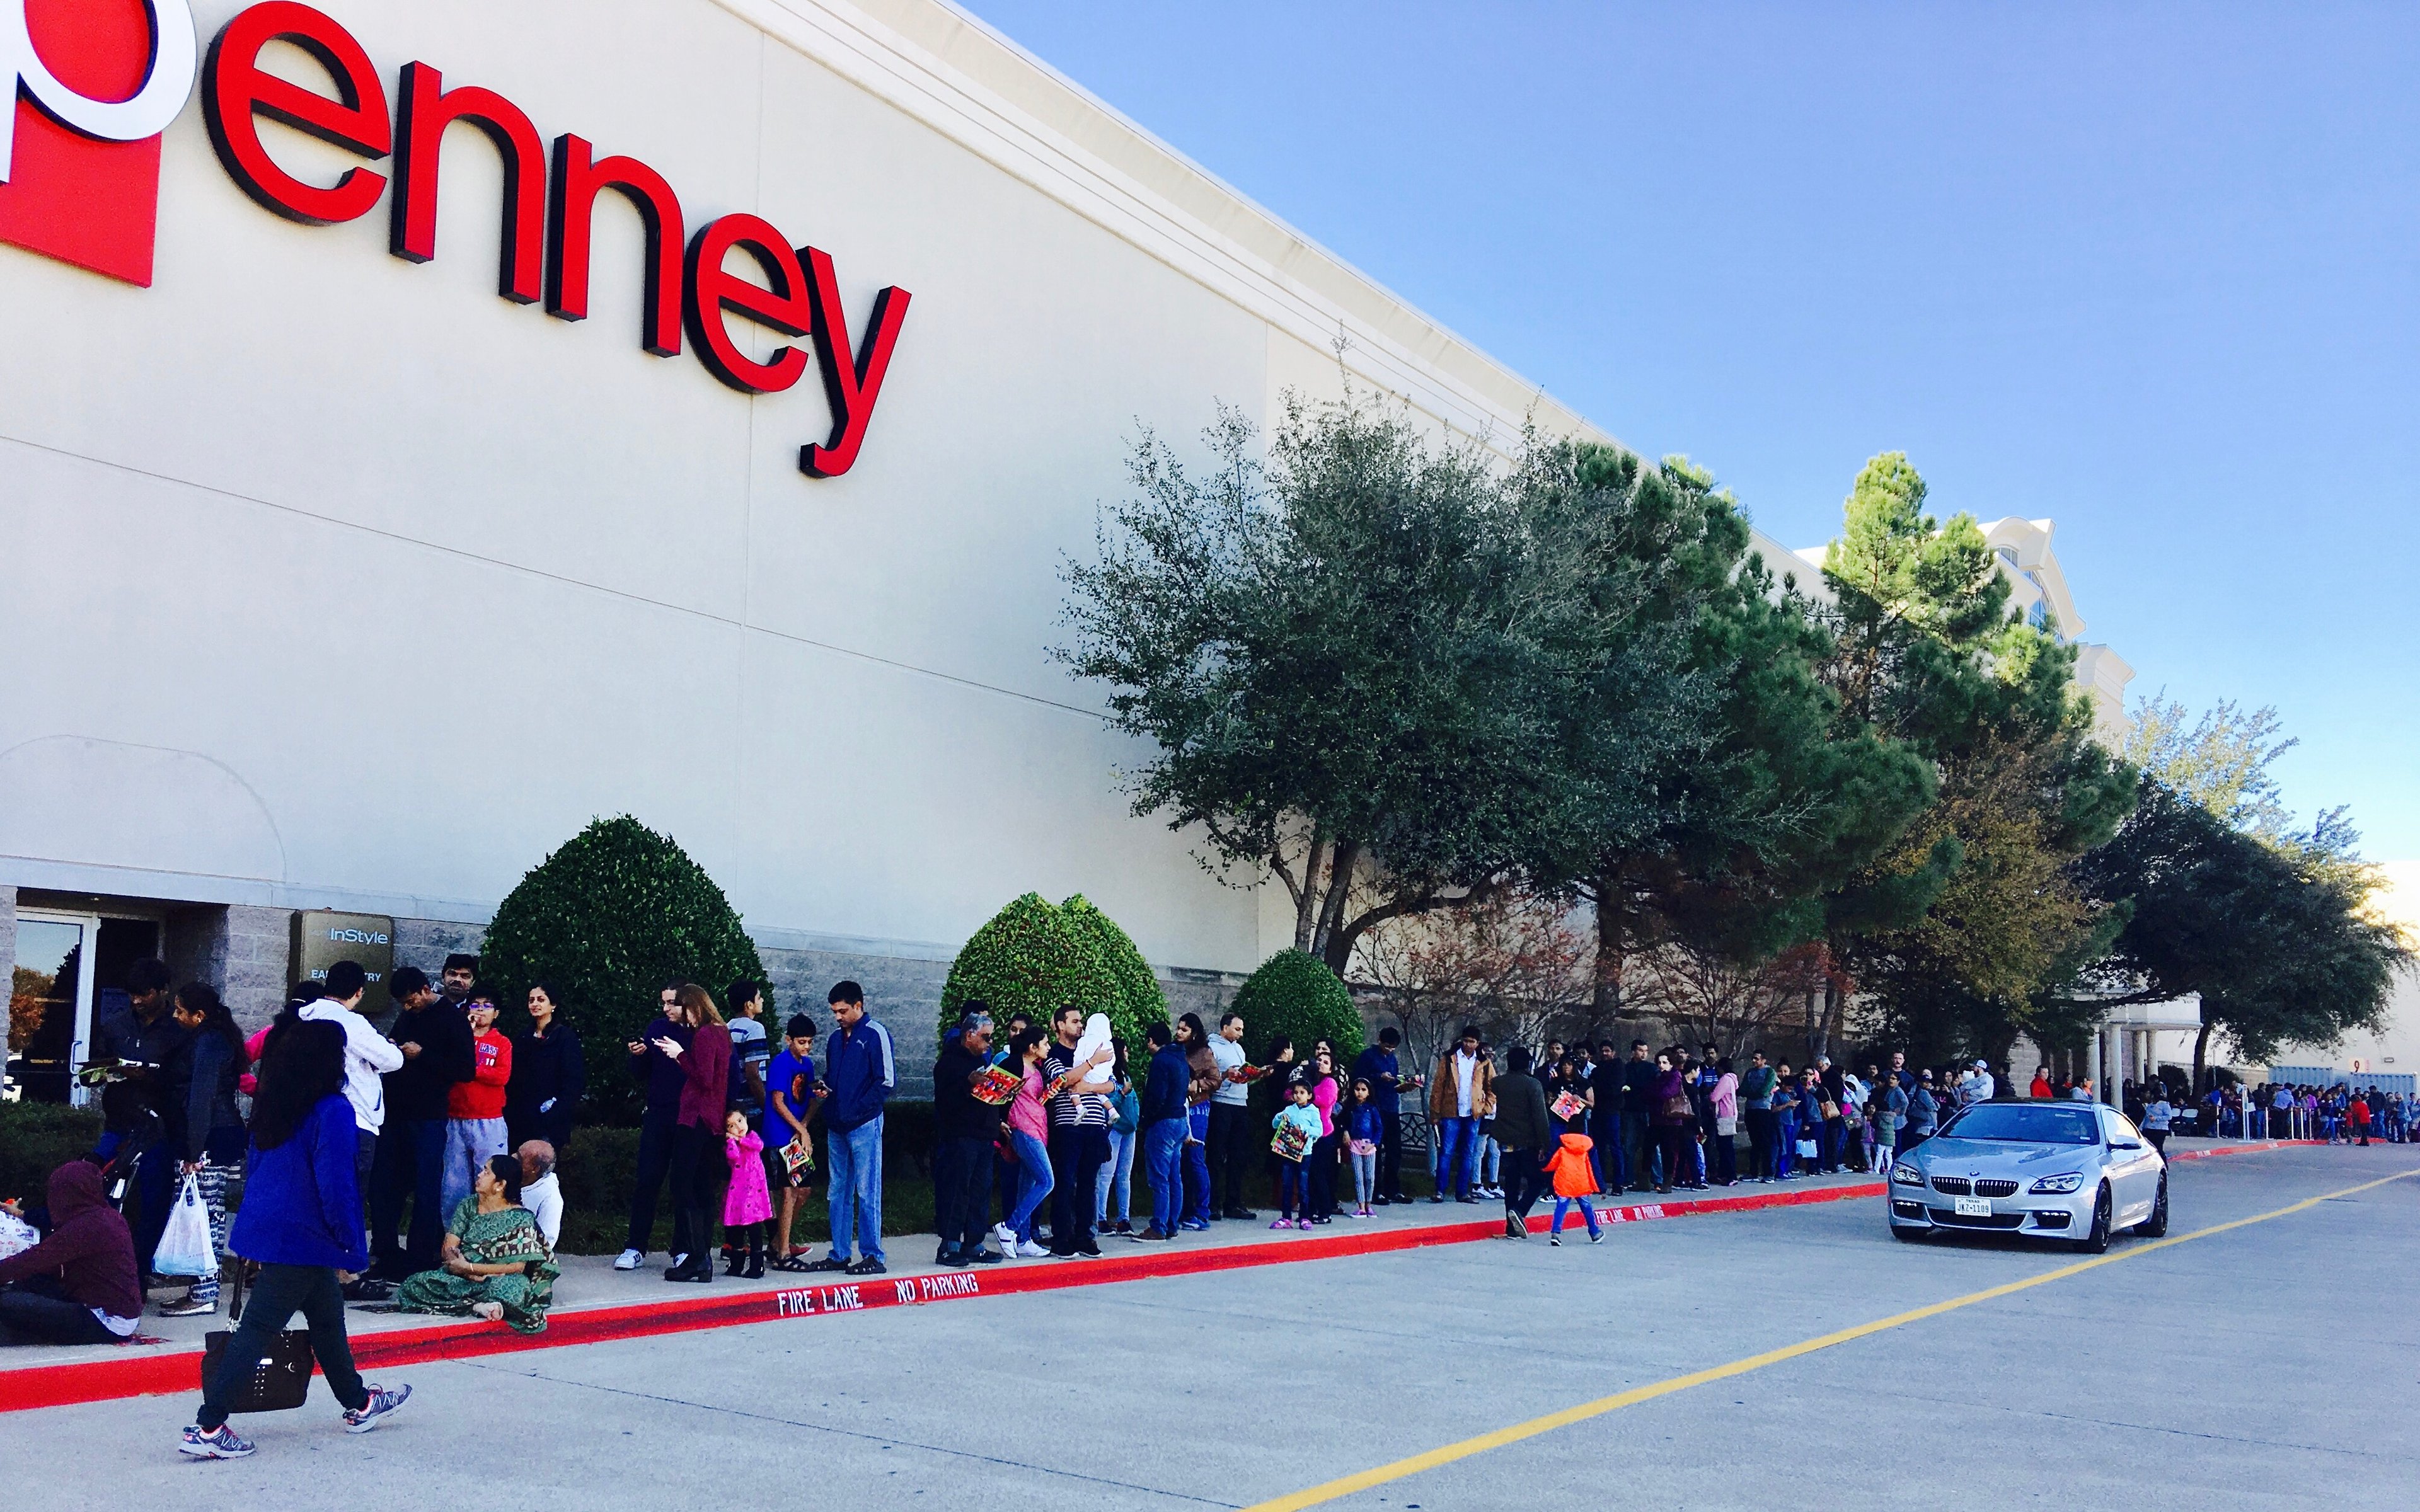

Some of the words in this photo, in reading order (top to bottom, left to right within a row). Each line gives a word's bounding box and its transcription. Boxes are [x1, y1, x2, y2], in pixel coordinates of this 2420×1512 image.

[330, 928, 388, 945] InStyle
[777, 1290, 815, 1316] FIRE
[821, 1286, 863, 1312] LANE
[894, 1280, 916, 1303] NO
[920, 1273, 979, 1300] PARKING
